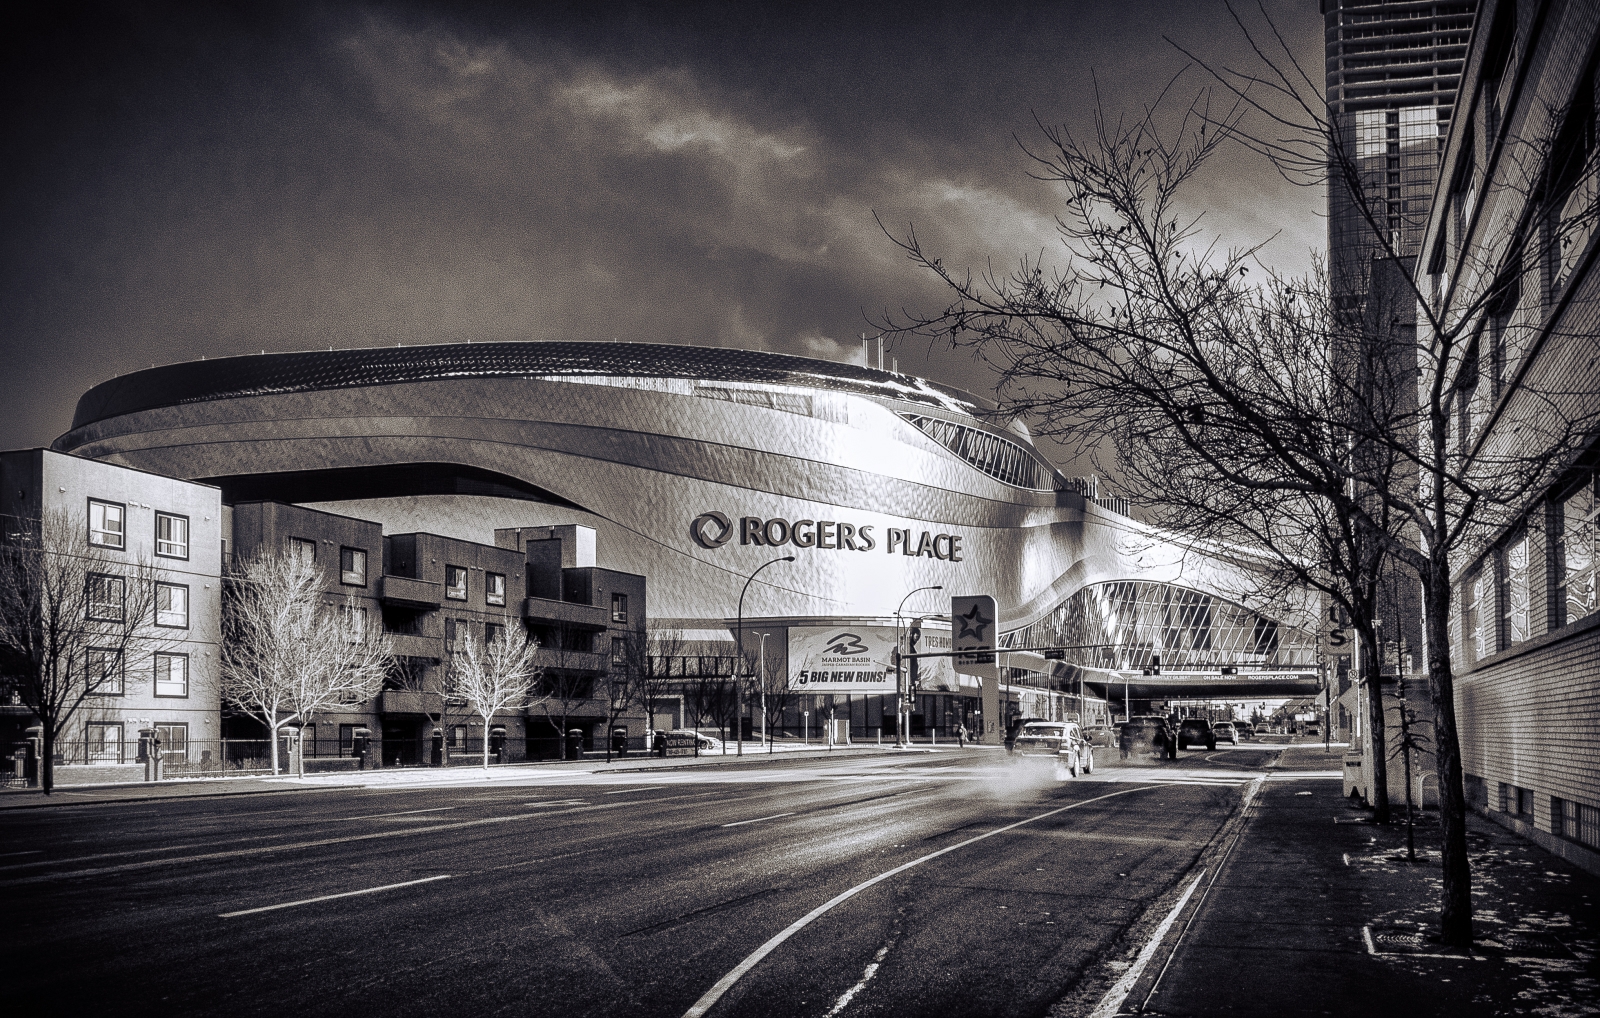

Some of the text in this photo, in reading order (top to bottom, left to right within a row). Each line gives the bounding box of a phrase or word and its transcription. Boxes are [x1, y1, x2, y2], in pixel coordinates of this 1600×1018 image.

[740, 516, 963, 562] ROGERS PLACE
[924, 635, 939, 648] TRES
[799, 670, 887, 685] 5 BIG NEW RUNS!
